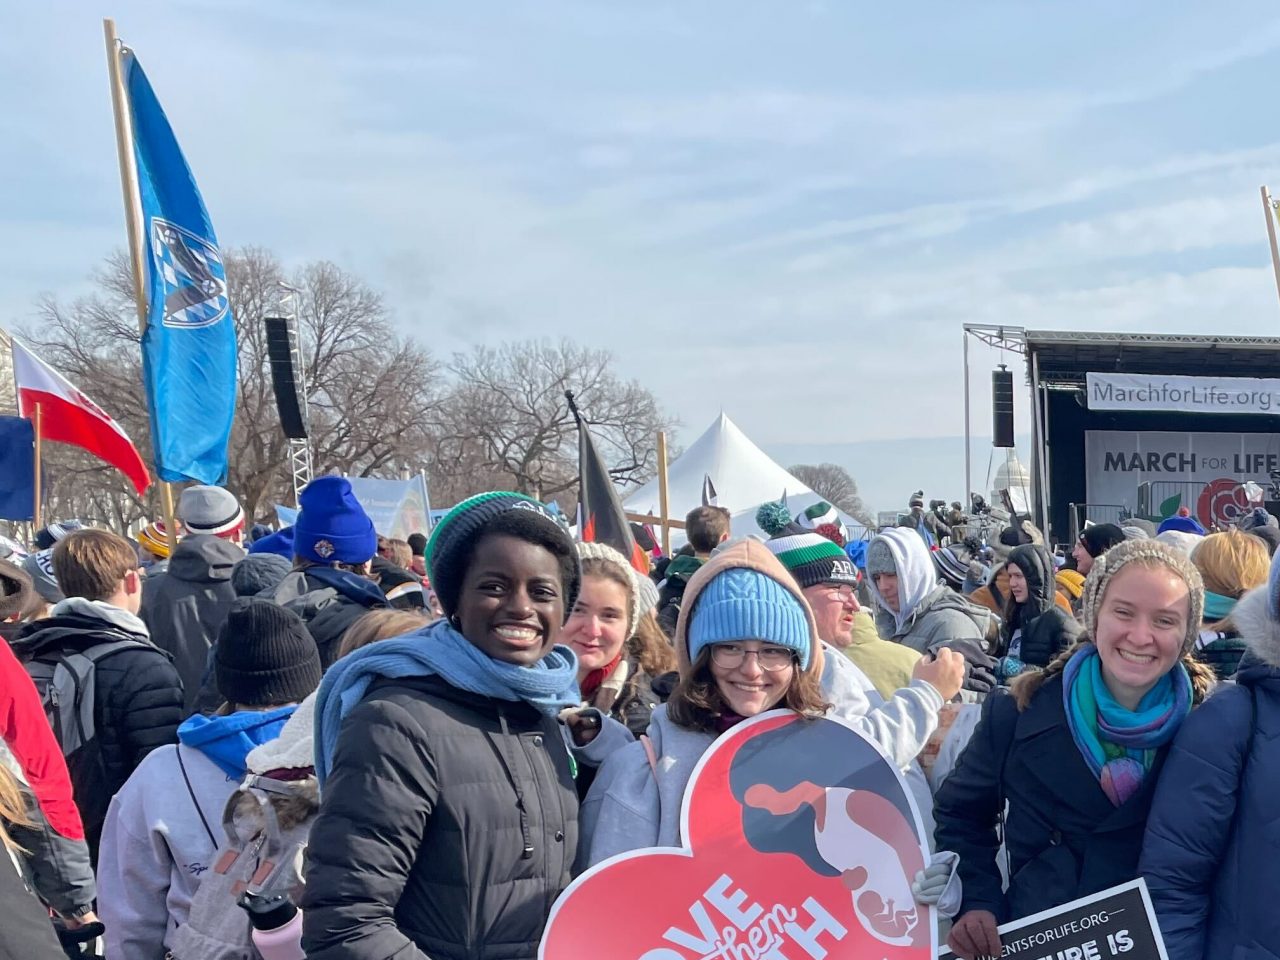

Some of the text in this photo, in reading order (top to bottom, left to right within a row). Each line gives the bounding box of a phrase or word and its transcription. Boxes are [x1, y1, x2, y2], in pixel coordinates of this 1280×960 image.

[1093, 382, 1272, 410] MarchforLife.org
[1103, 451, 1277, 474] MARCH FOR LIFE
[1107, 929, 1134, 955] IS
